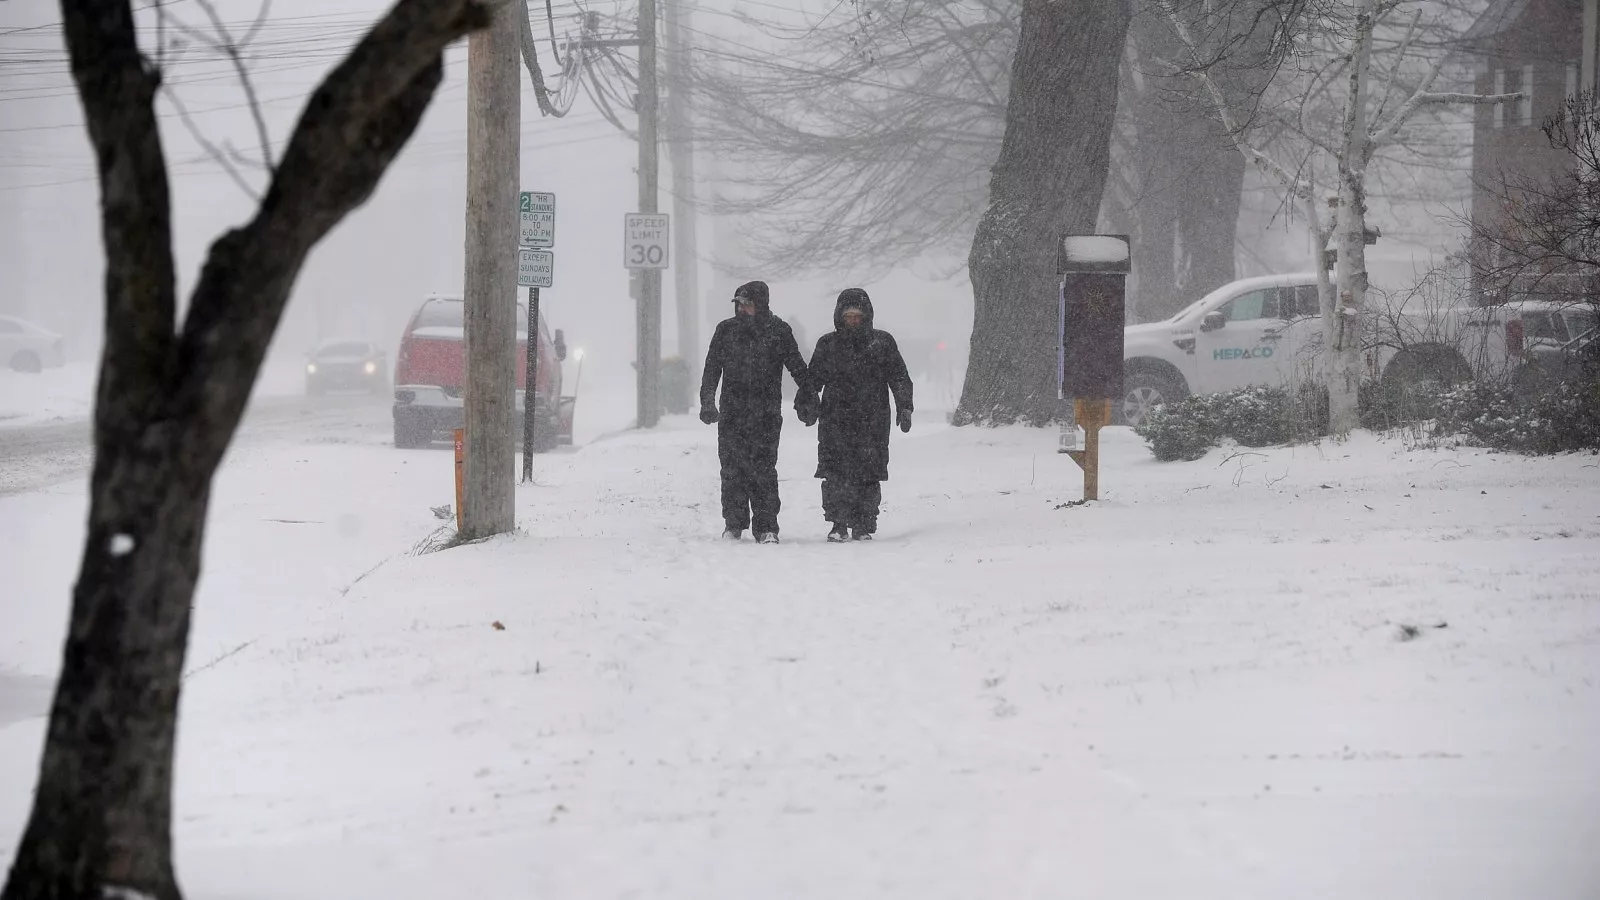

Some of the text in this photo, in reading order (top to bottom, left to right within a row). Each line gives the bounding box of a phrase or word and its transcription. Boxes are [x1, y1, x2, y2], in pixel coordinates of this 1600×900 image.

[521, 195, 530, 210] 2
[522, 213, 552, 222] 8:00 AM
[532, 221, 541, 229] TO
[629, 218, 666, 228] SPEED
[522, 229, 551, 238] 6:00 PM
[632, 230, 662, 240] LIMIT
[523, 253, 548, 262] EXCEPT
[630, 244, 663, 264] 30
[520, 264, 550, 273] SUNDAYS
[519, 275, 550, 284] HOLIDAYS
[1213, 347, 1273, 360] HEPACO
